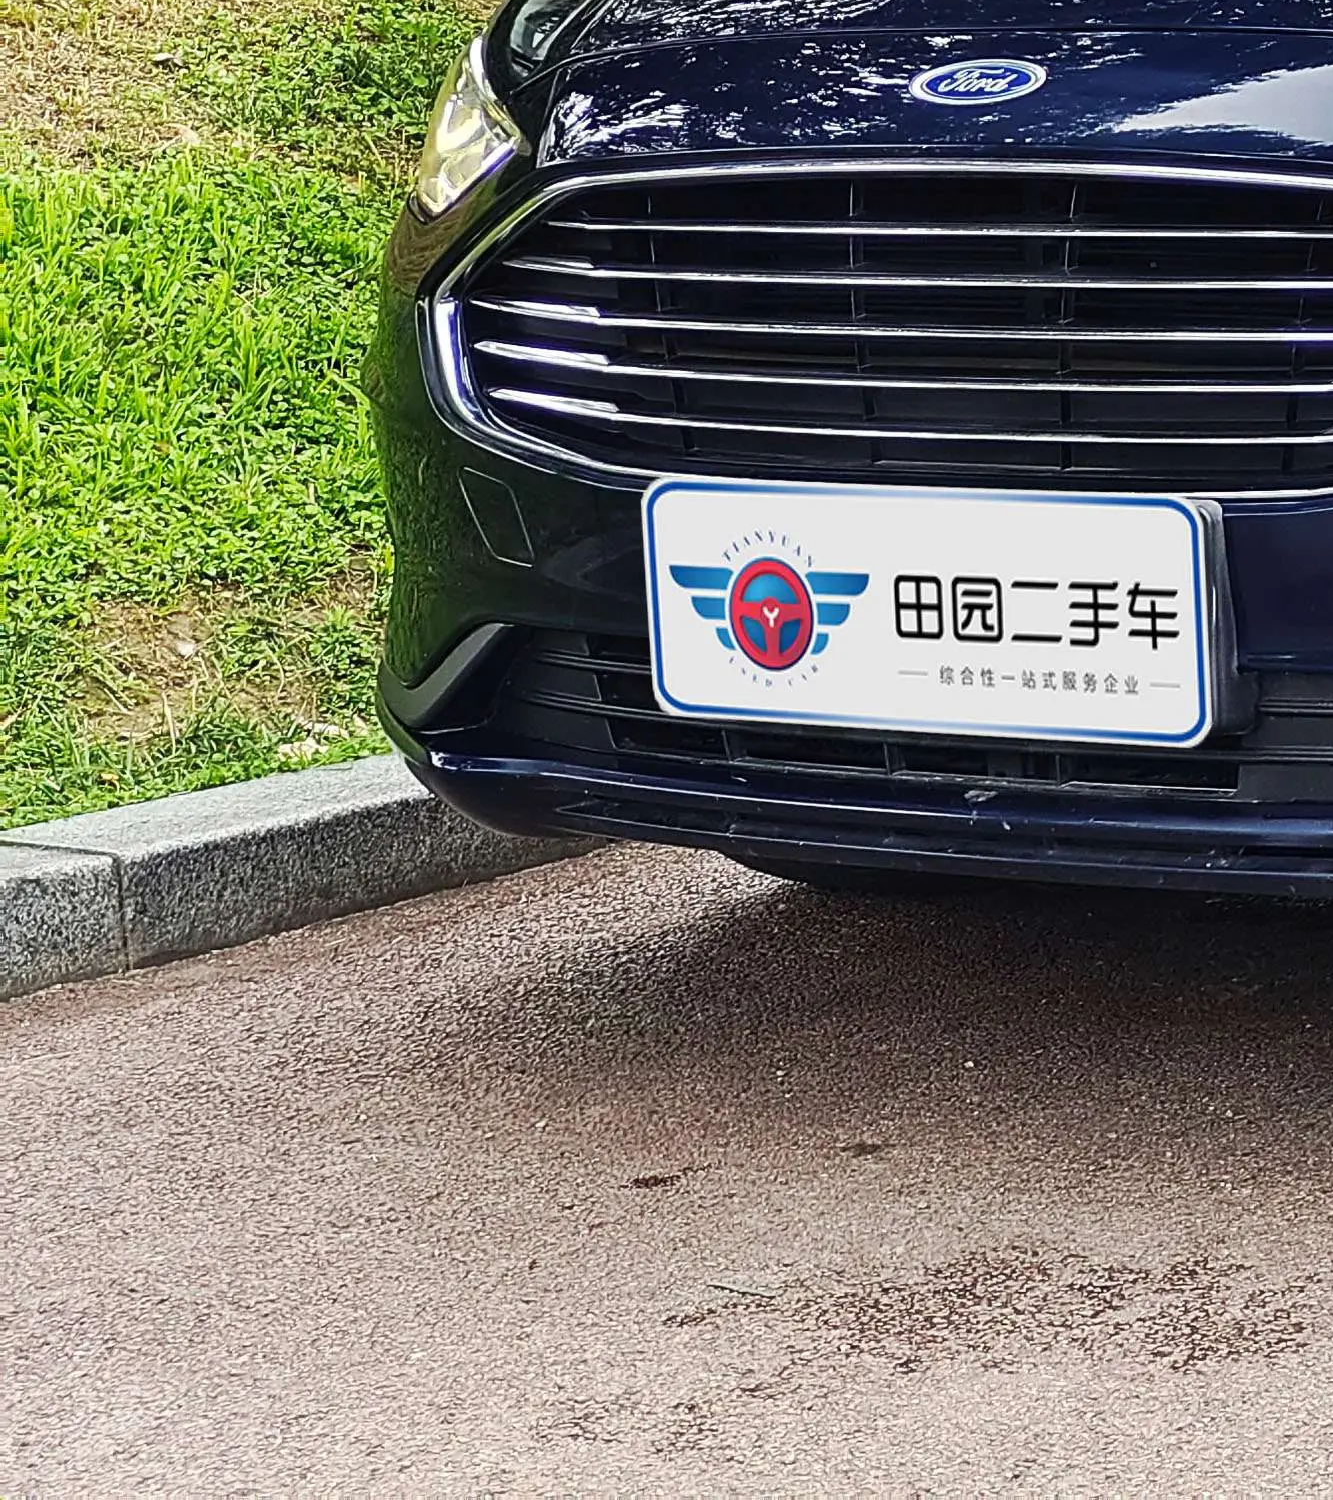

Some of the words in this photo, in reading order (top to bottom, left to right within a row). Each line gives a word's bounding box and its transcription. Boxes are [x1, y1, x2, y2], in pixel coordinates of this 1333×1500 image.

[937, 67, 1023, 93] Ford
[893, 574, 1180, 650] 田园二手车
[938, 664, 1140, 696] 综合性一站式服务企业
